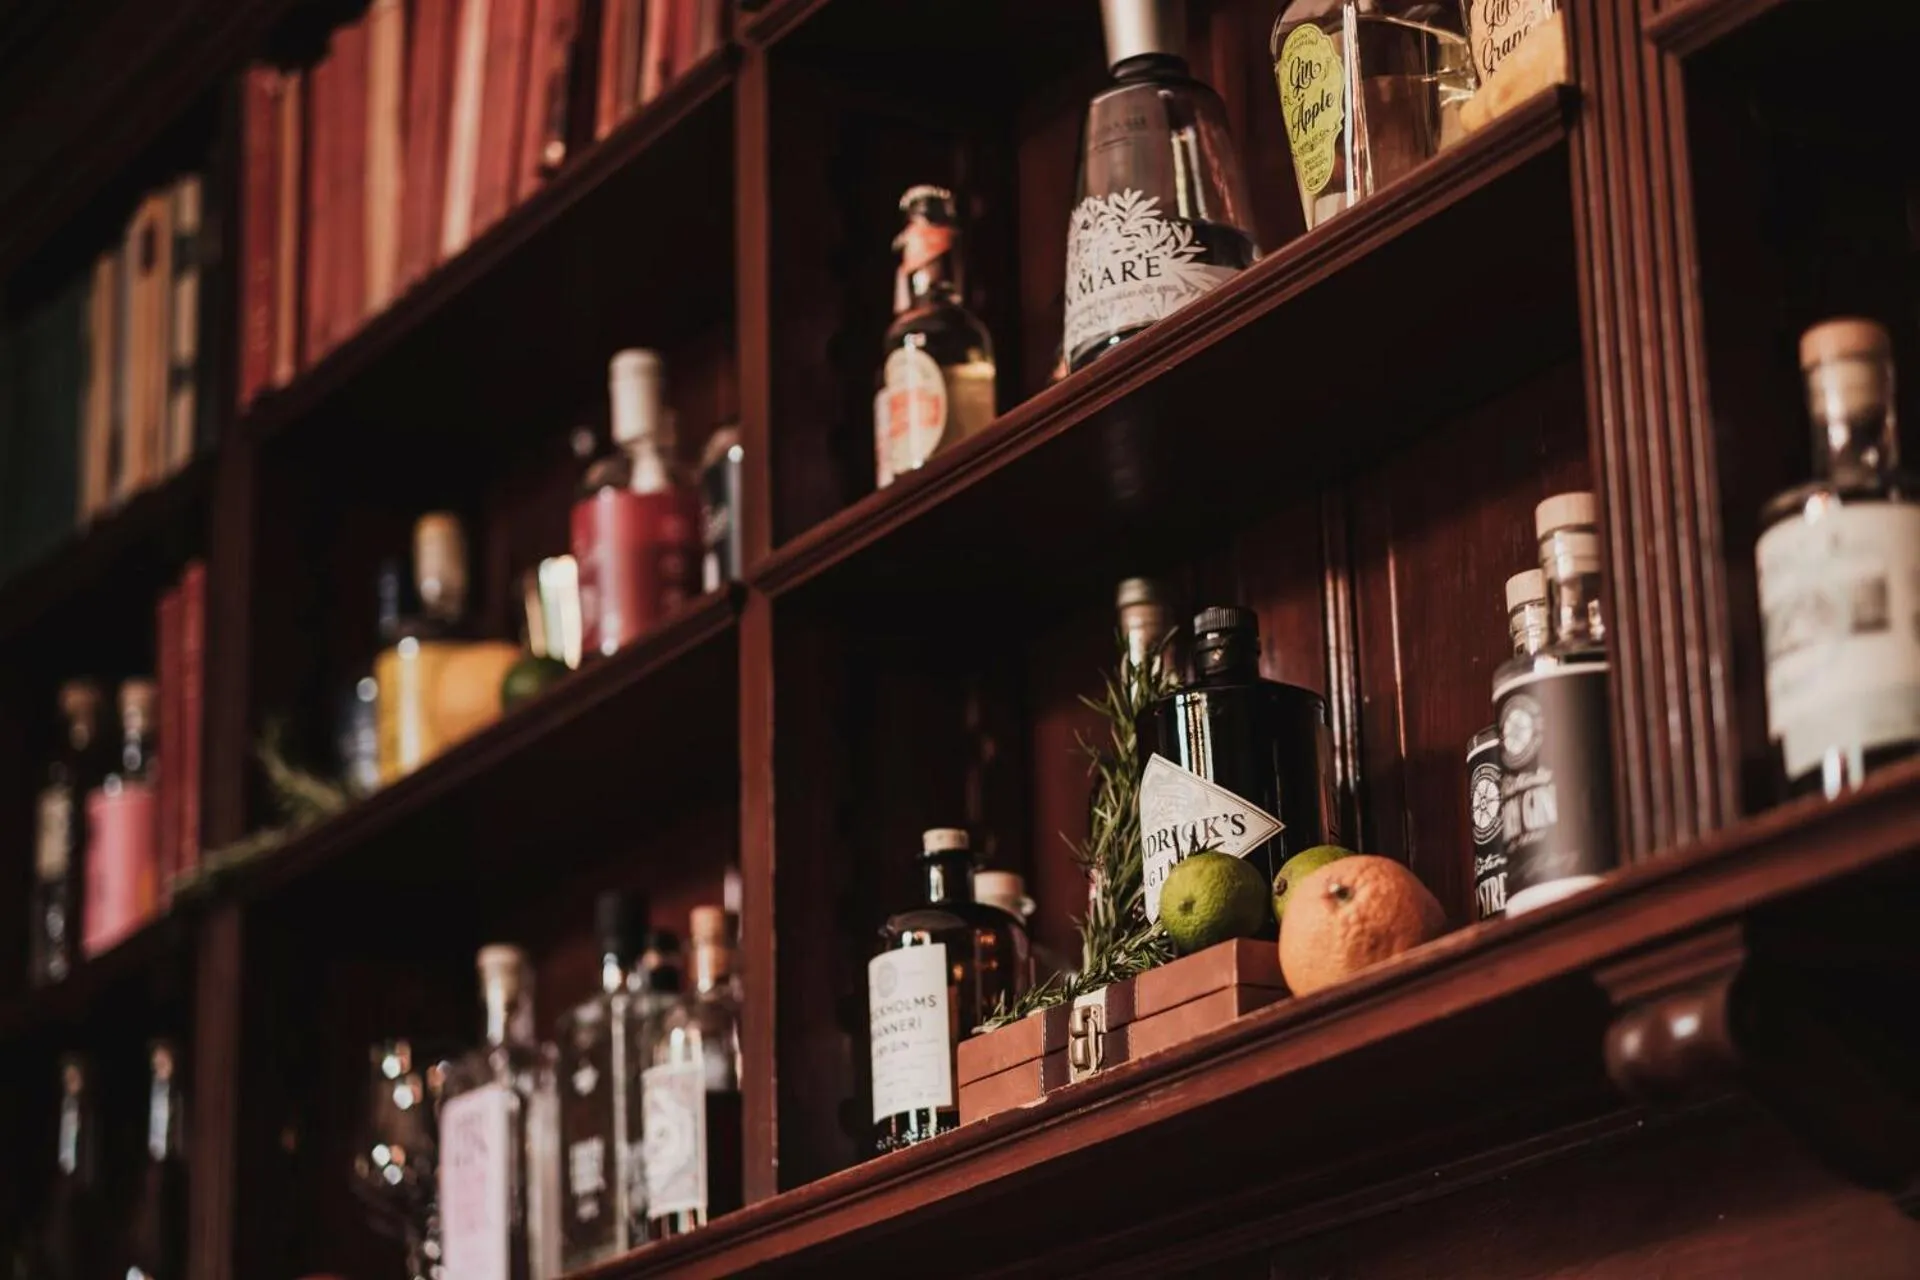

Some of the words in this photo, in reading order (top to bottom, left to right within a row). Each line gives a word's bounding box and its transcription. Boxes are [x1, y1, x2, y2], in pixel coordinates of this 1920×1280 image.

[1289, 56, 1321, 98] Gin
[1078, 255, 1162, 296] MARE
[1144, 813, 1247, 859] DRICK'S
